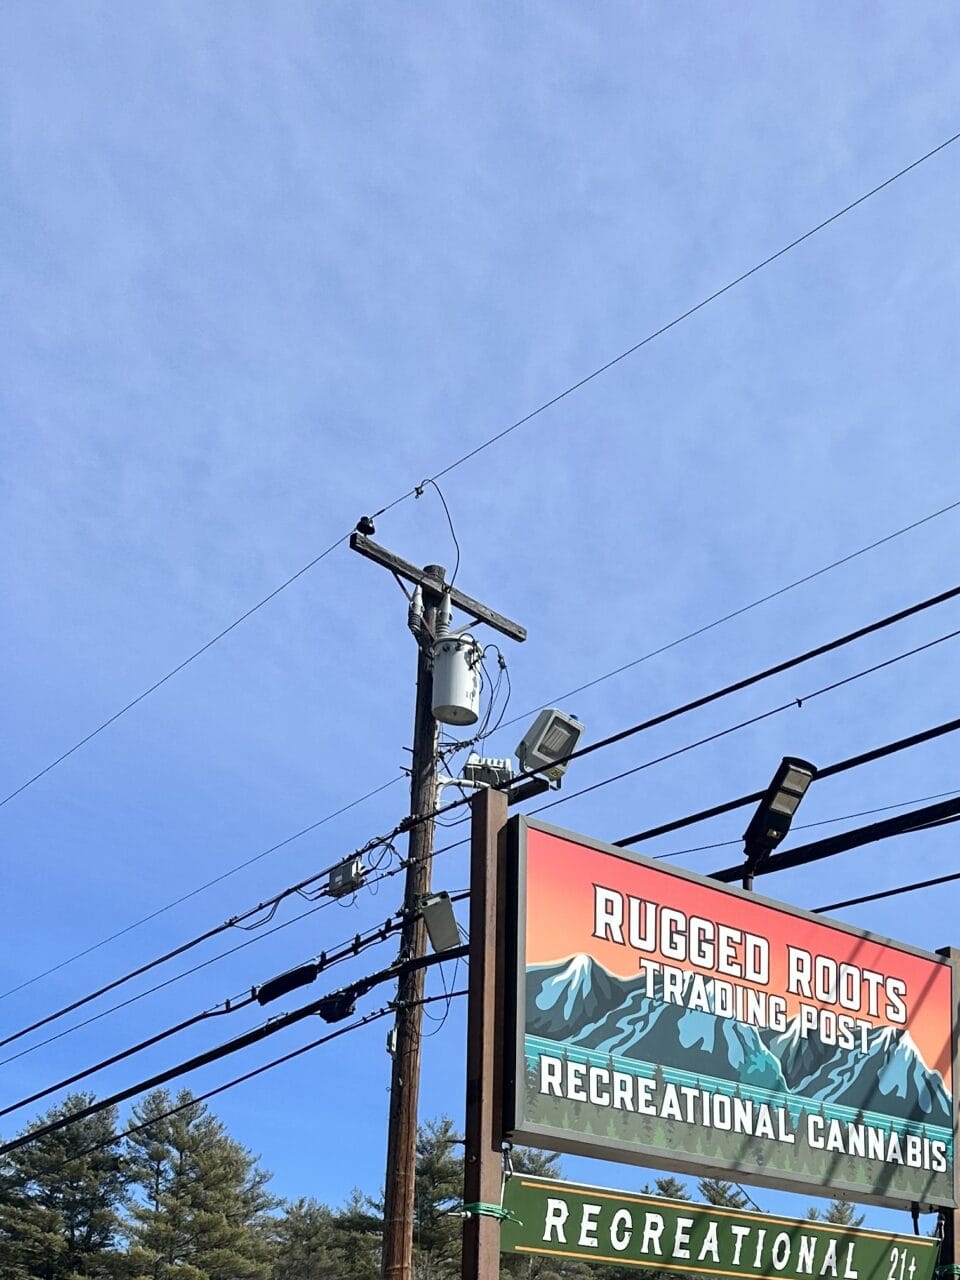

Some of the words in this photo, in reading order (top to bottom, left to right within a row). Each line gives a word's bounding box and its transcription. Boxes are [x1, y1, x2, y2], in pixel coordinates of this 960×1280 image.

[592, 884, 769, 986] RUGGED
[787, 944, 907, 1024] ROOTS
[640, 957, 787, 1033] TRADING
[800, 1002, 873, 1055] POST
[538, 1054, 796, 1144] RECREATIONAL
[807, 1114, 948, 1173] CANNABIS
[542, 1198, 858, 1280] RECREATIONAL
